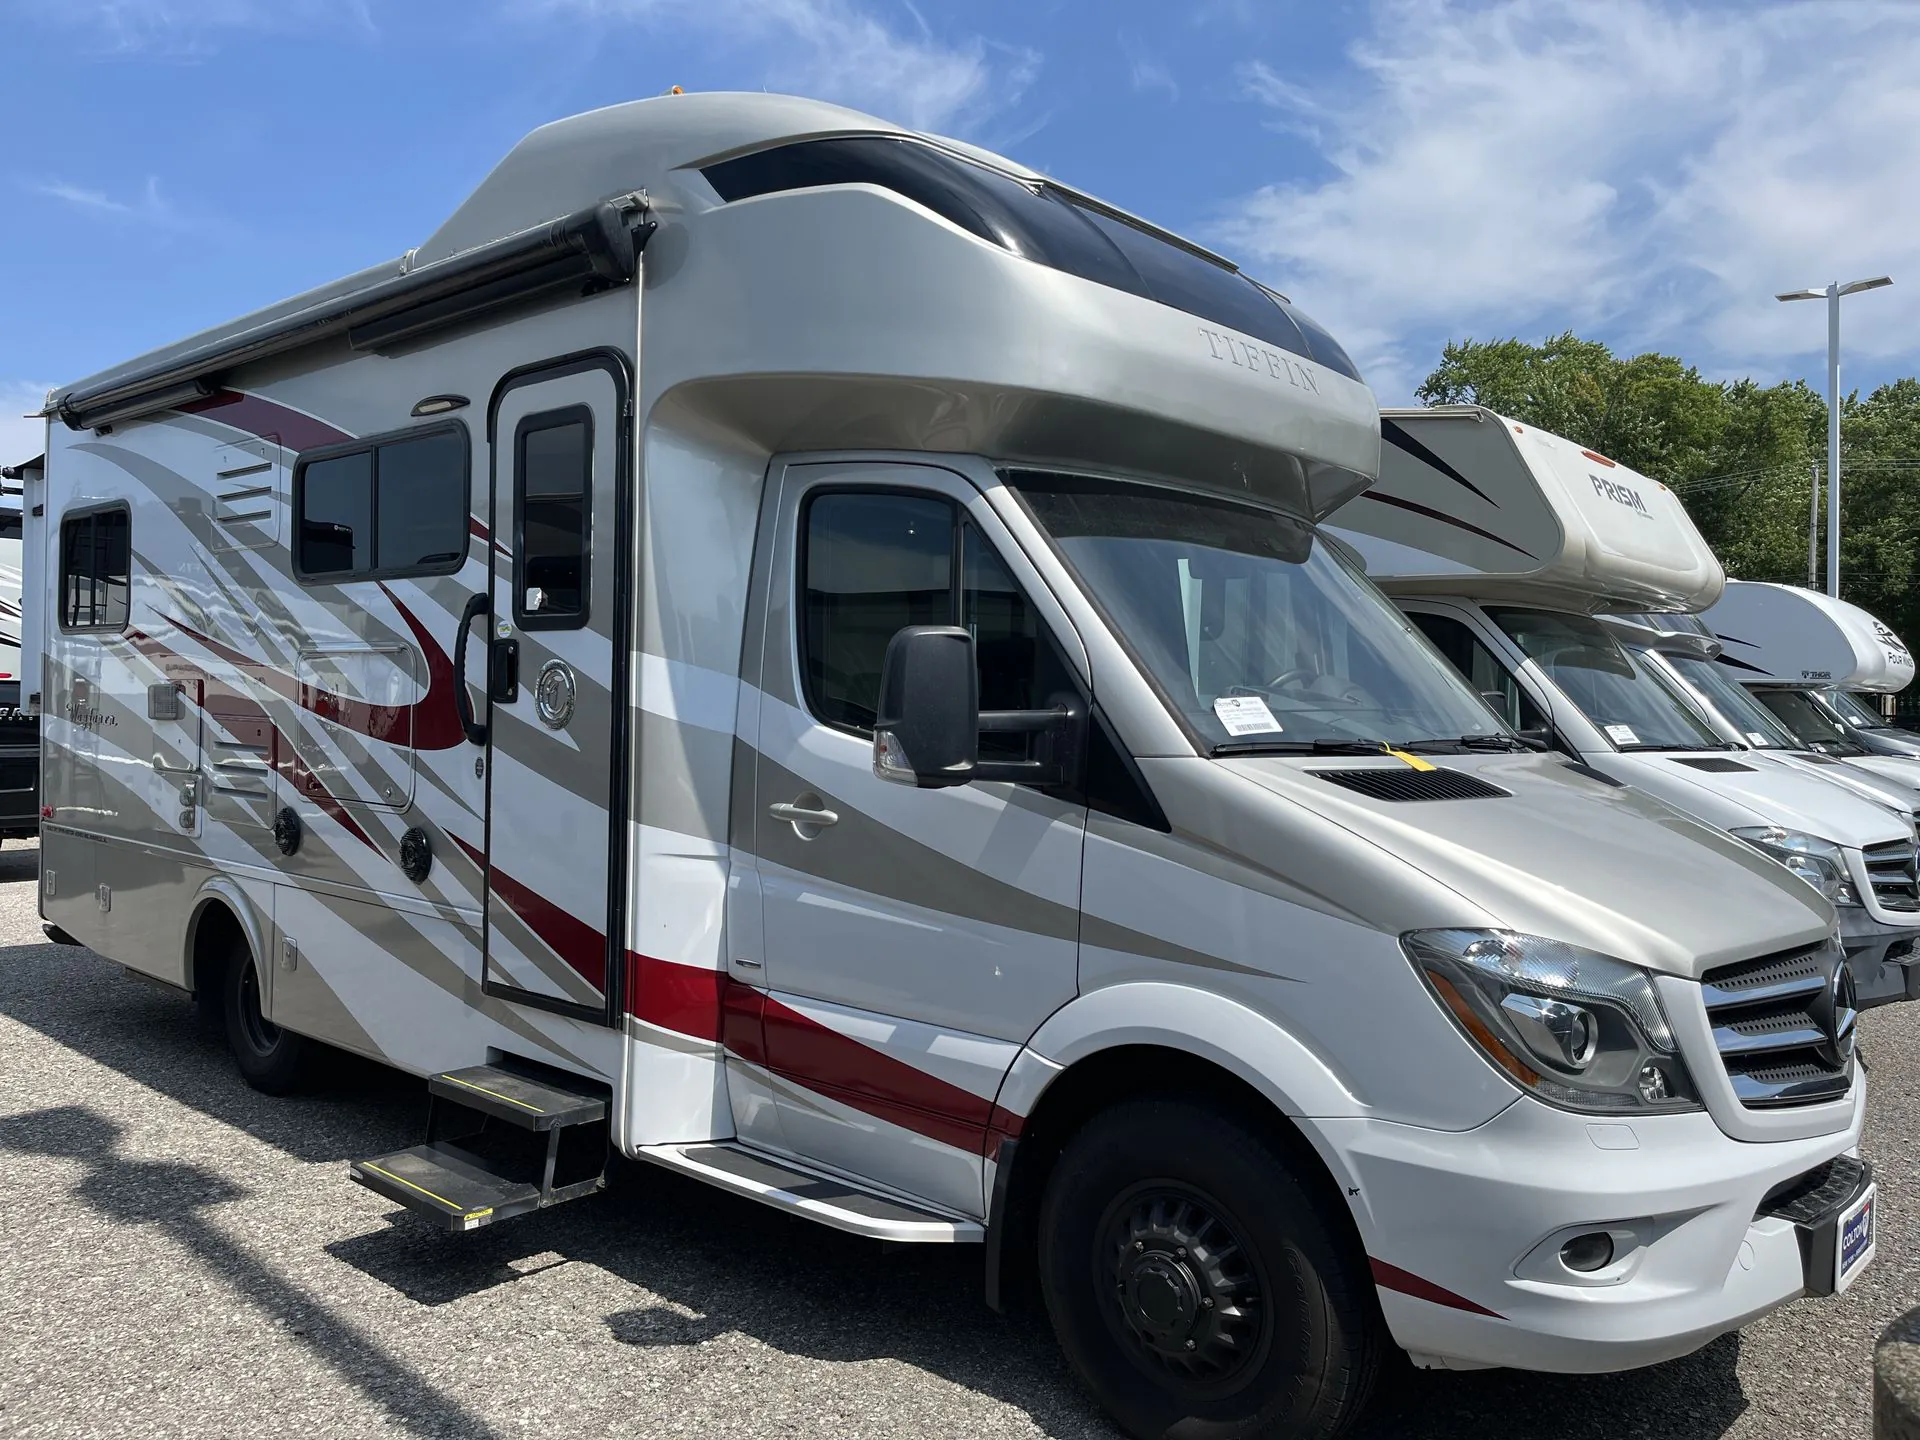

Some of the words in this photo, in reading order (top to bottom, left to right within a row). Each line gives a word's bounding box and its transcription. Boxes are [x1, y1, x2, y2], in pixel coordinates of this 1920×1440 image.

[1198, 327, 1320, 396] TIFFIN
[1588, 473, 1647, 513] PRISM
[1809, 671, 1832, 679] THOR
